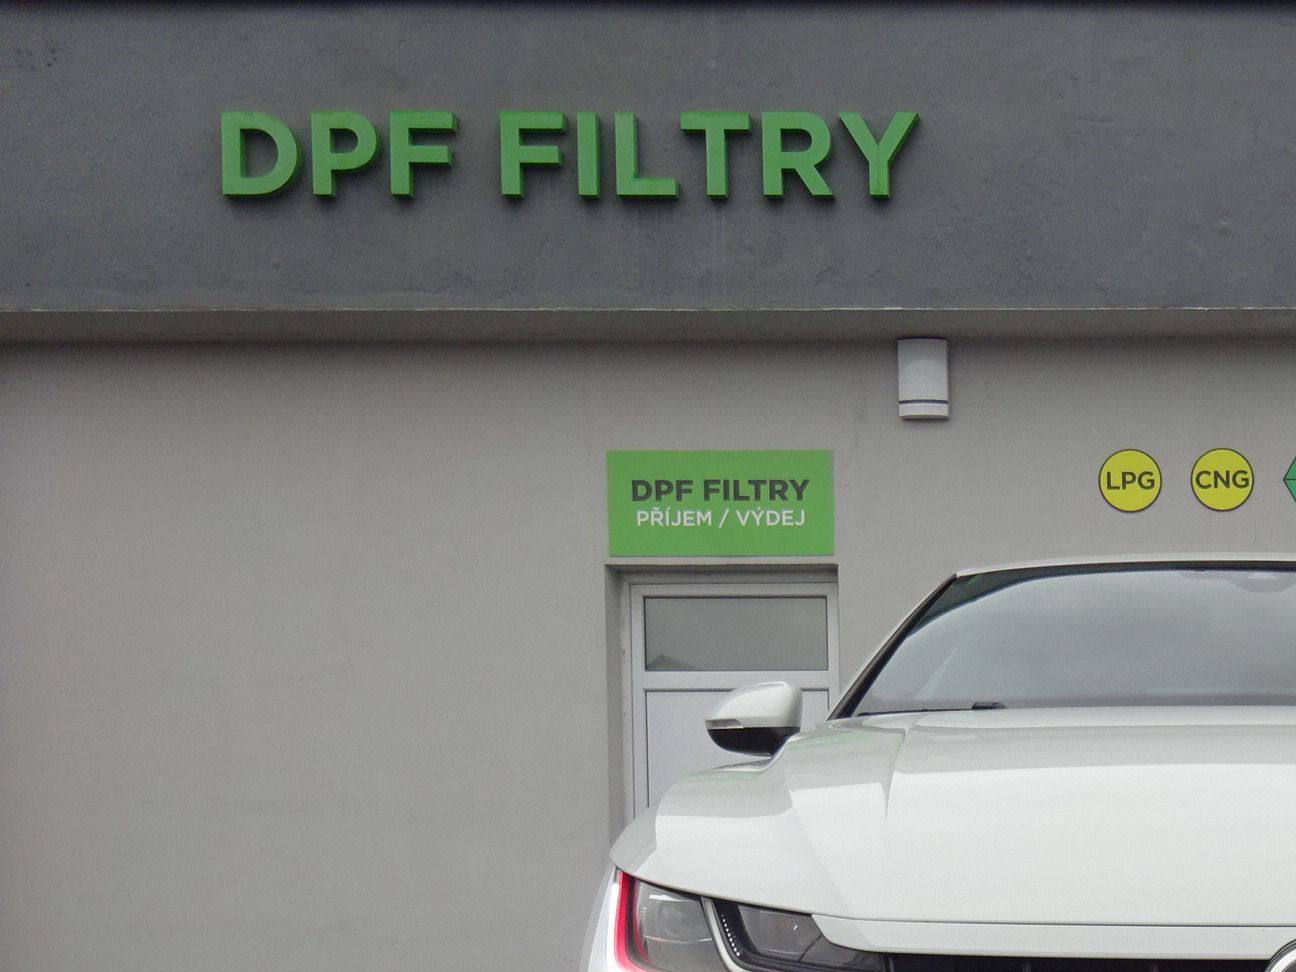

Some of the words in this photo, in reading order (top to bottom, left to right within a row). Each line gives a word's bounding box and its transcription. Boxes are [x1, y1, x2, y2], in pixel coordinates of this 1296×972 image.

[220, 110, 458, 198] DPF
[498, 111, 919, 199] FILTRY
[631, 479, 694, 501] DPF
[703, 479, 810, 501] FILTRY
[1106, 470, 1155, 490] LPG
[1195, 470, 1250, 489] CNG
[636, 506, 712, 527] PŘÍJEM
[718, 508, 730, 528] /
[736, 506, 805, 527] VÝDEJ
